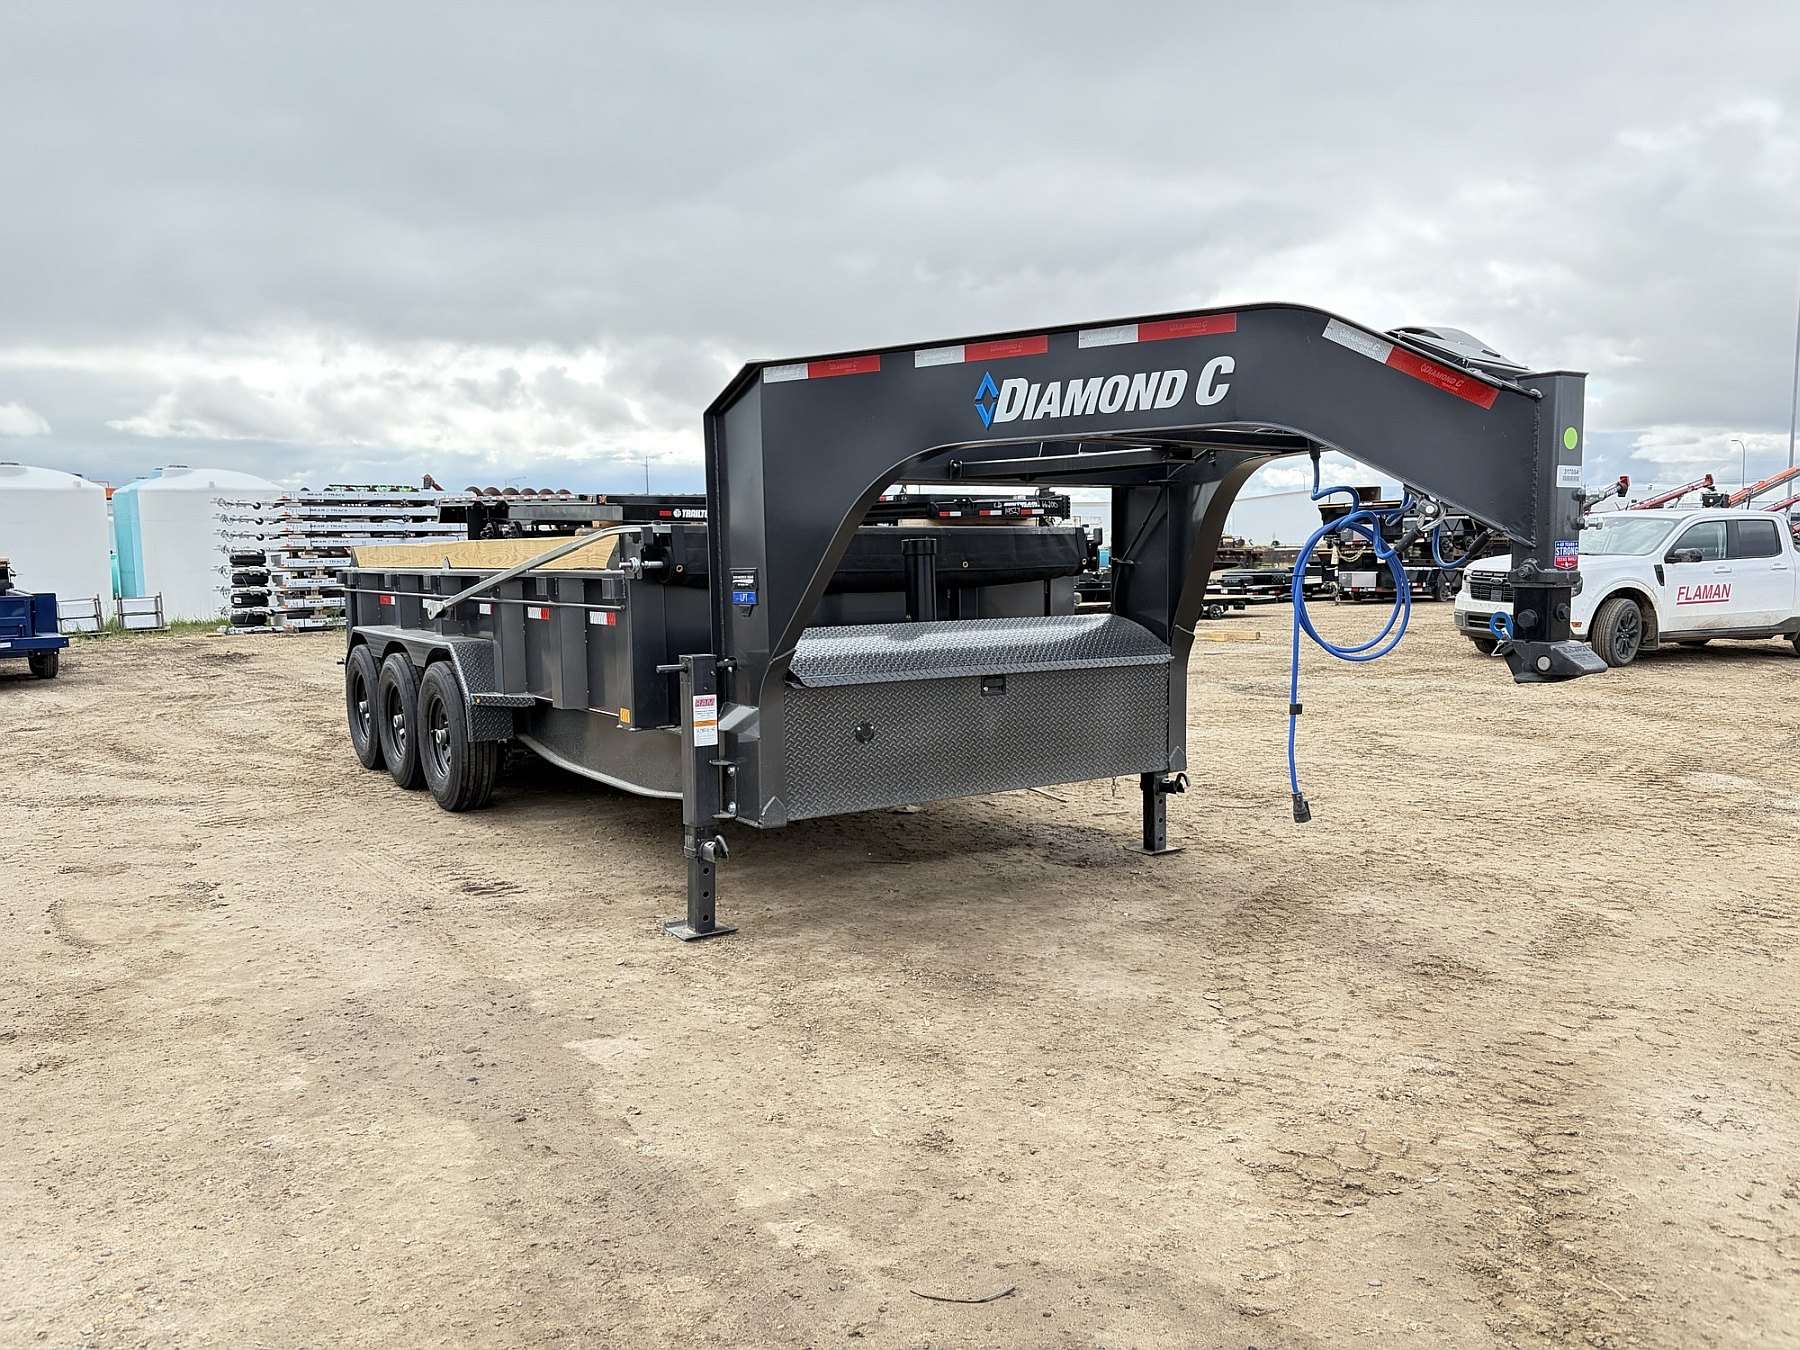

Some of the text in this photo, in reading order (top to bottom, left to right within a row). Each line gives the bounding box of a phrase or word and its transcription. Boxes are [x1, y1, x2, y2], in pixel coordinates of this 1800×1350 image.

[993, 356, 1236, 423] DIAMOND C
[1677, 584, 1732, 601] FLAMAN
